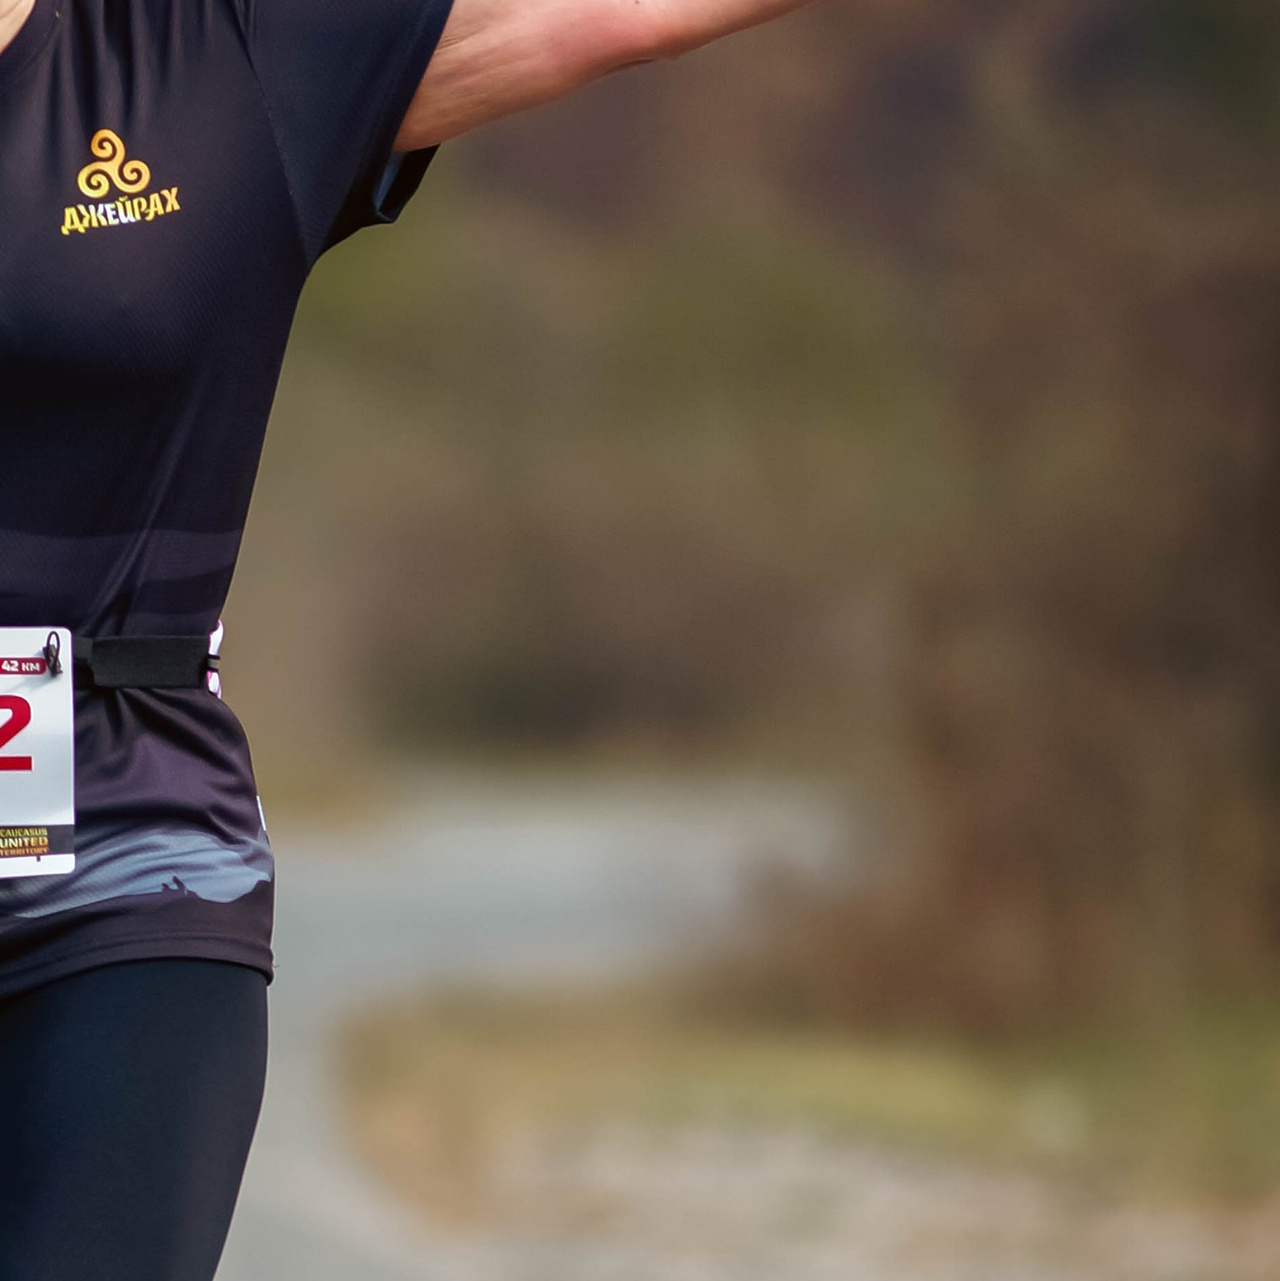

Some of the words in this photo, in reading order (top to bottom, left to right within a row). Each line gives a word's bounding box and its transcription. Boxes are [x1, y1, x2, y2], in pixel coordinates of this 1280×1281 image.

[60, 187, 181, 235] ДЖЕЙРАХ
[1, 660, 19, 672] 42
[0, 828, 48, 837] CAUCASUS
[0, 837, 49, 848] UNITED
[0, 847, 48, 856] TERRITORY
